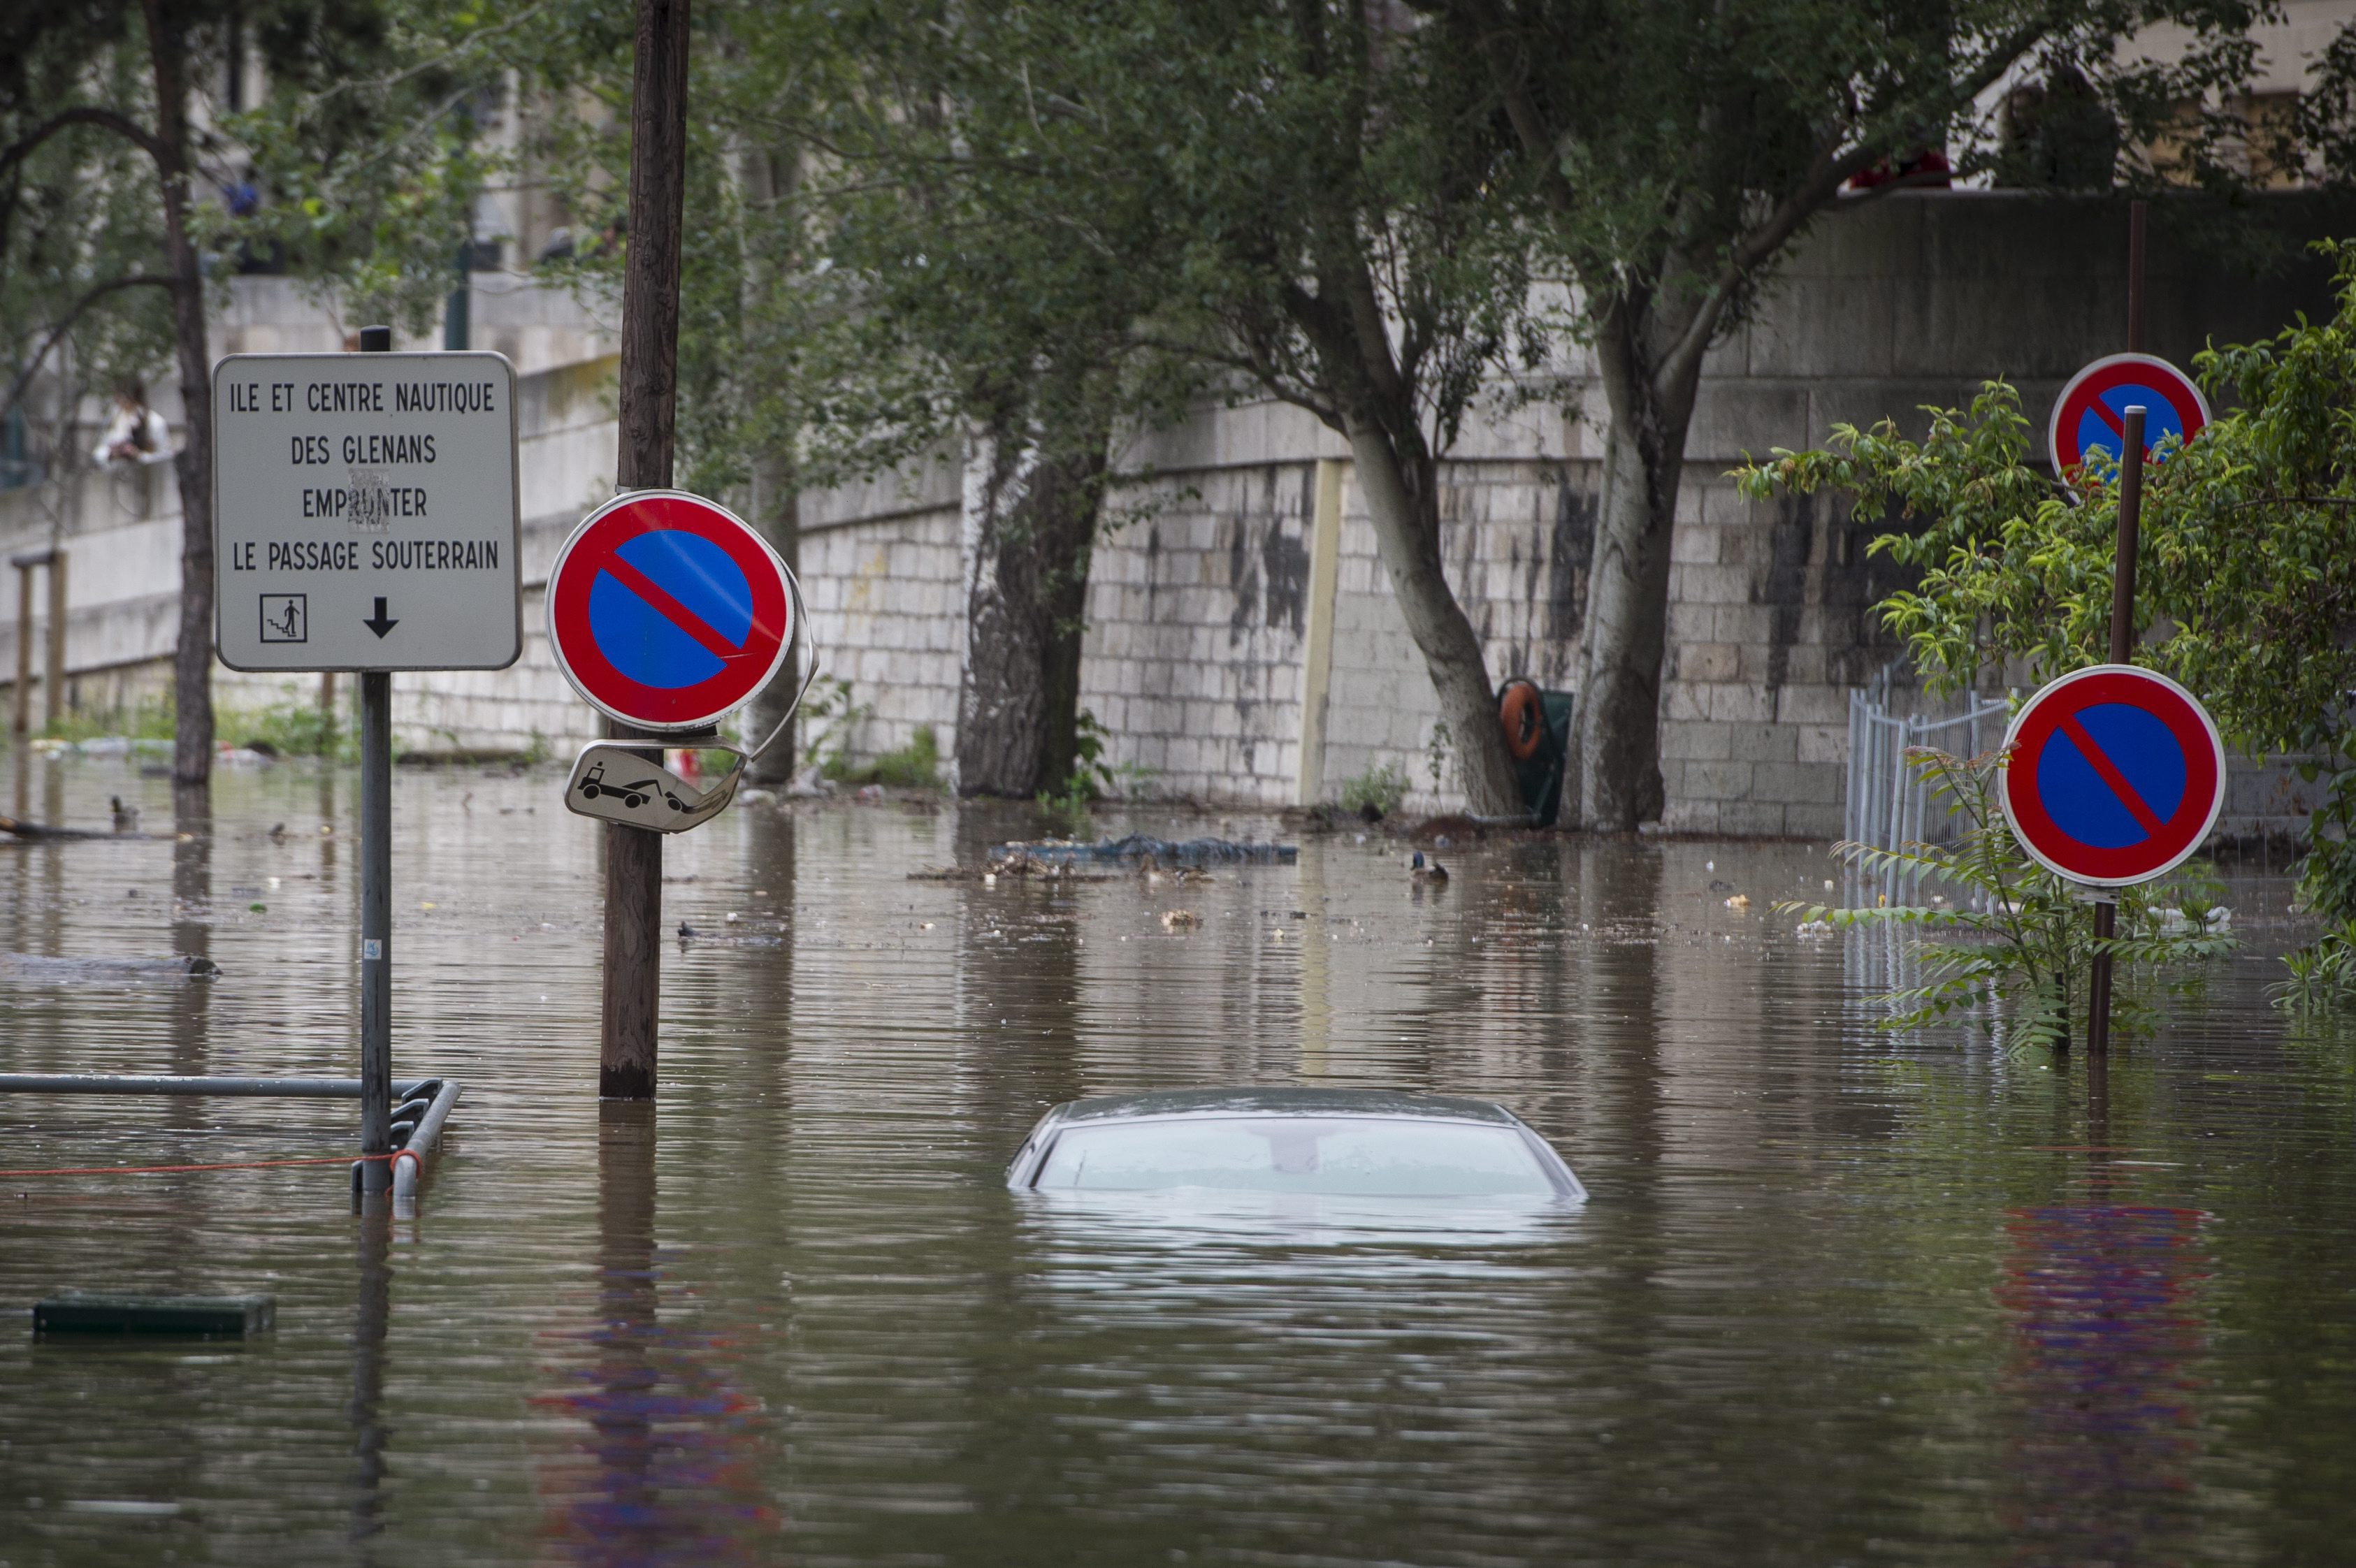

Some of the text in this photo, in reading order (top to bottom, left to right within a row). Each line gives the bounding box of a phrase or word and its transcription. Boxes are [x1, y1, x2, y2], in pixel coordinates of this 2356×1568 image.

[230, 382, 494, 414] ILE ET CENTRE NAUTIQUE
[291, 434, 436, 465] DES GLENANS
[233, 540, 498, 571] LE PASSAGE SOUTERRAIN
